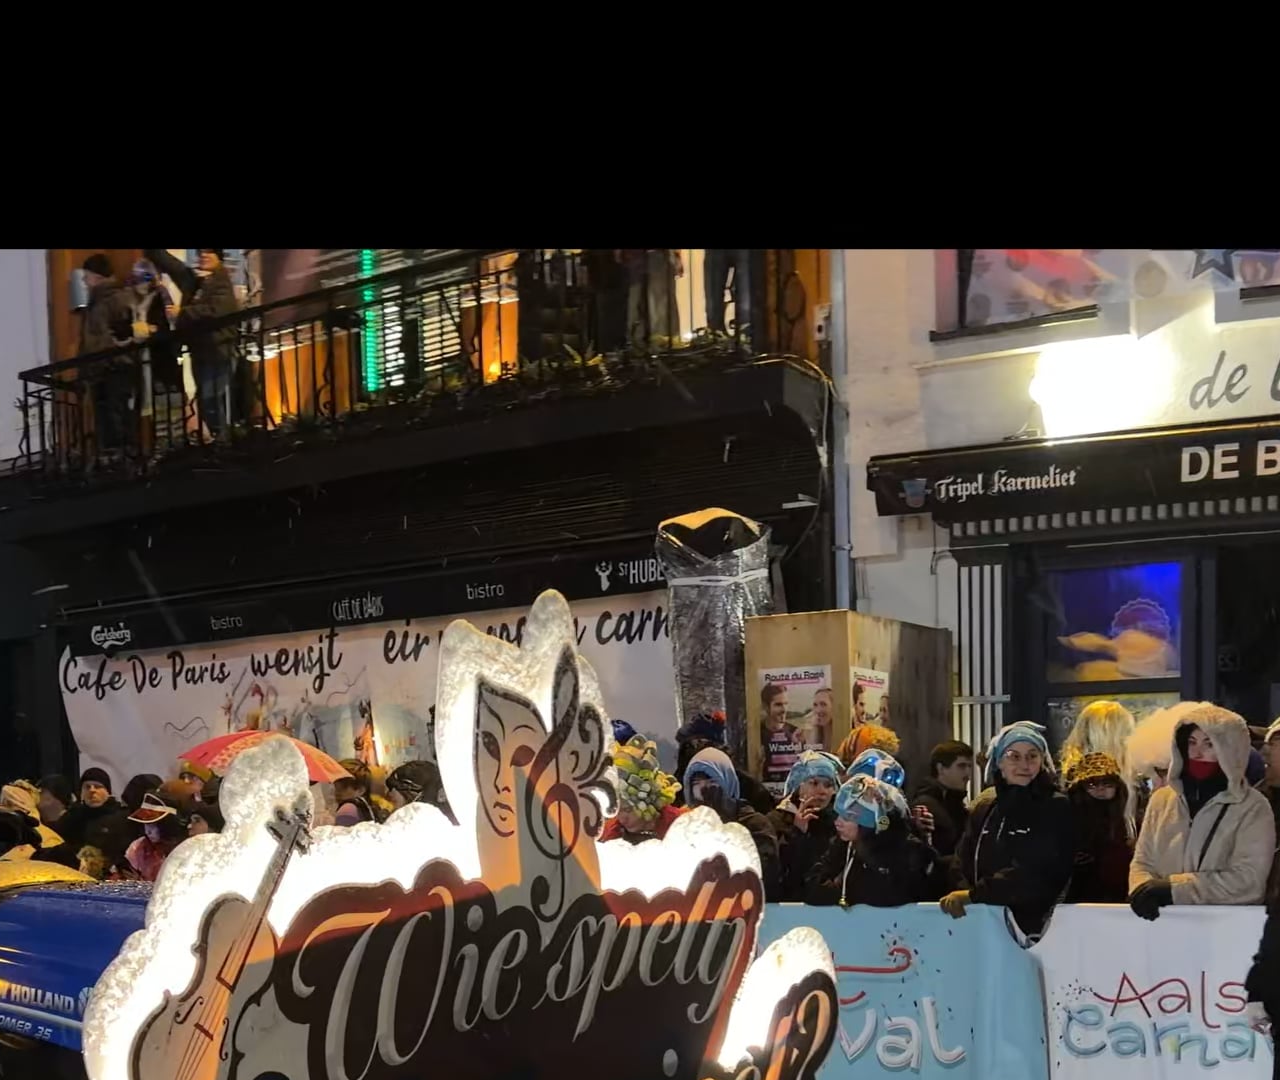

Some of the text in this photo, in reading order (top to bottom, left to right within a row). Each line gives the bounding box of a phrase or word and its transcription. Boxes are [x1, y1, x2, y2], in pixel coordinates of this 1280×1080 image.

[1189, 350, 1250, 411] de
[1181, 442, 1241, 483] DE
[935, 464, 1077, 503] Tripel Karmeliet
[466, 582, 505, 600] bistro
[91, 622, 132, 649] Carlsberg
[211, 616, 243, 630] bistro
[63, 653, 127, 700] Cafe
[127, 655, 163, 694] De
[167, 650, 231, 691] Paris
[532, 881, 756, 1043] speltj
[10, 984, 75, 1014] HOLLAND
[1092, 970, 1247, 1029] Aals
[34, 1025, 54, 1041] 35
[1061, 1003, 1275, 1069] Carna
